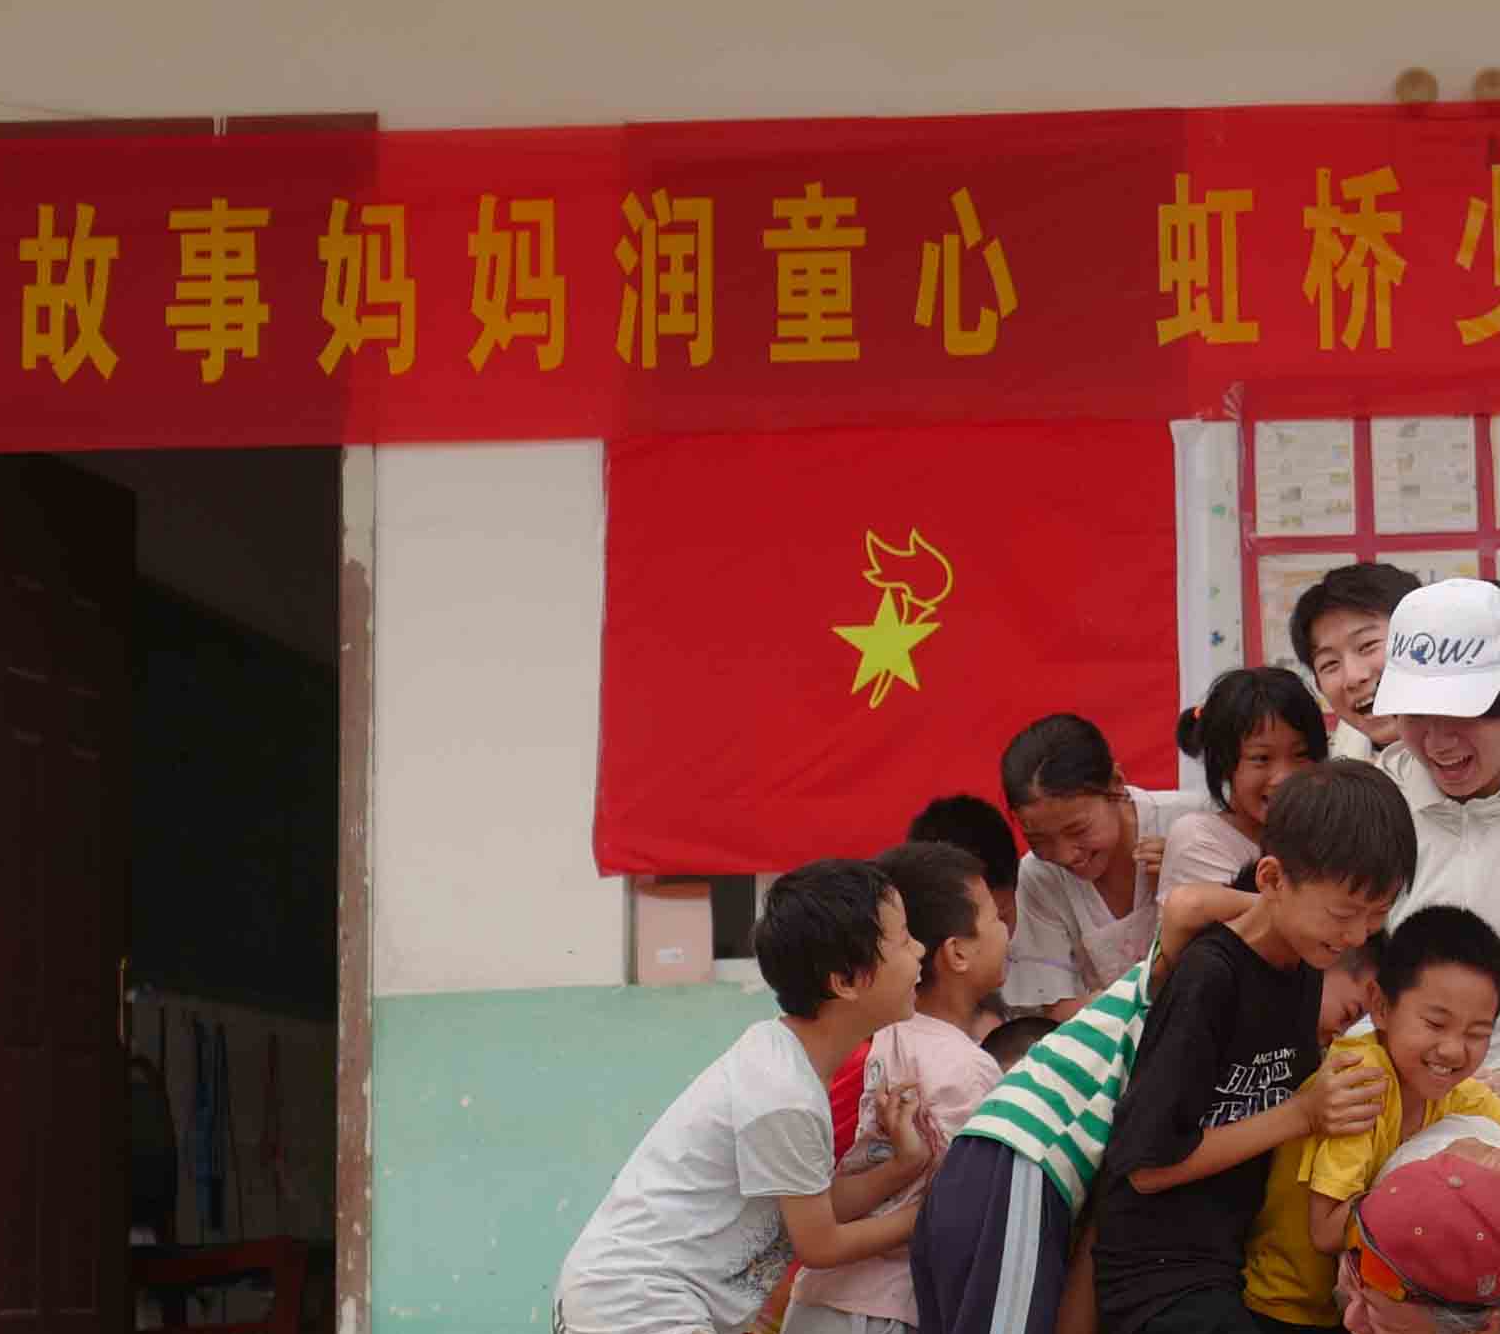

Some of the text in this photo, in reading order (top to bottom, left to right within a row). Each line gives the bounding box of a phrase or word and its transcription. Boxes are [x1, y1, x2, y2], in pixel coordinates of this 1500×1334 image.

[19, 181, 1019, 384] 故事妈妈润童心
[1392, 632, 1485, 665] WOW!
